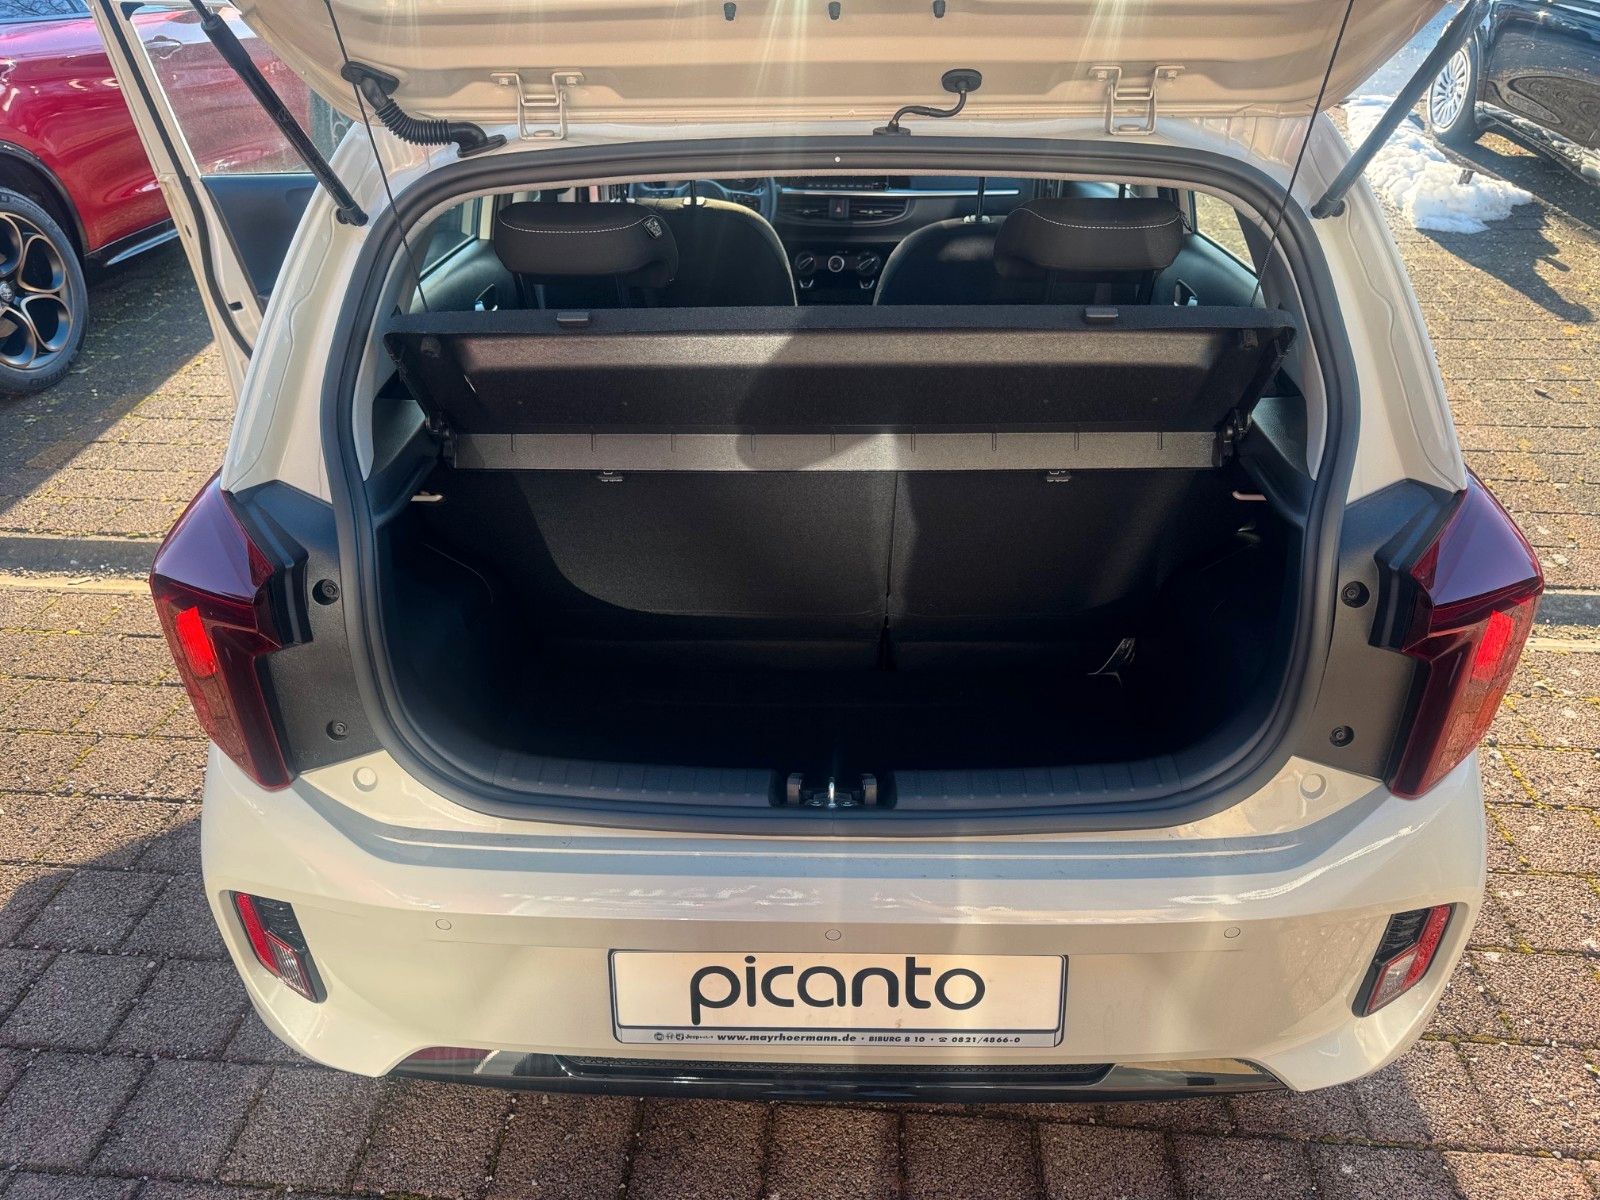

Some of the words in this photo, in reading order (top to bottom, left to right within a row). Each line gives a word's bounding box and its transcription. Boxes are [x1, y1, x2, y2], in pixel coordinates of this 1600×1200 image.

[690, 955, 986, 1026] picanto
[717, 1033, 857, 1043] www.mayrhoermann.de
[951, 1036, 1021, 1044] 0821/4866-0
